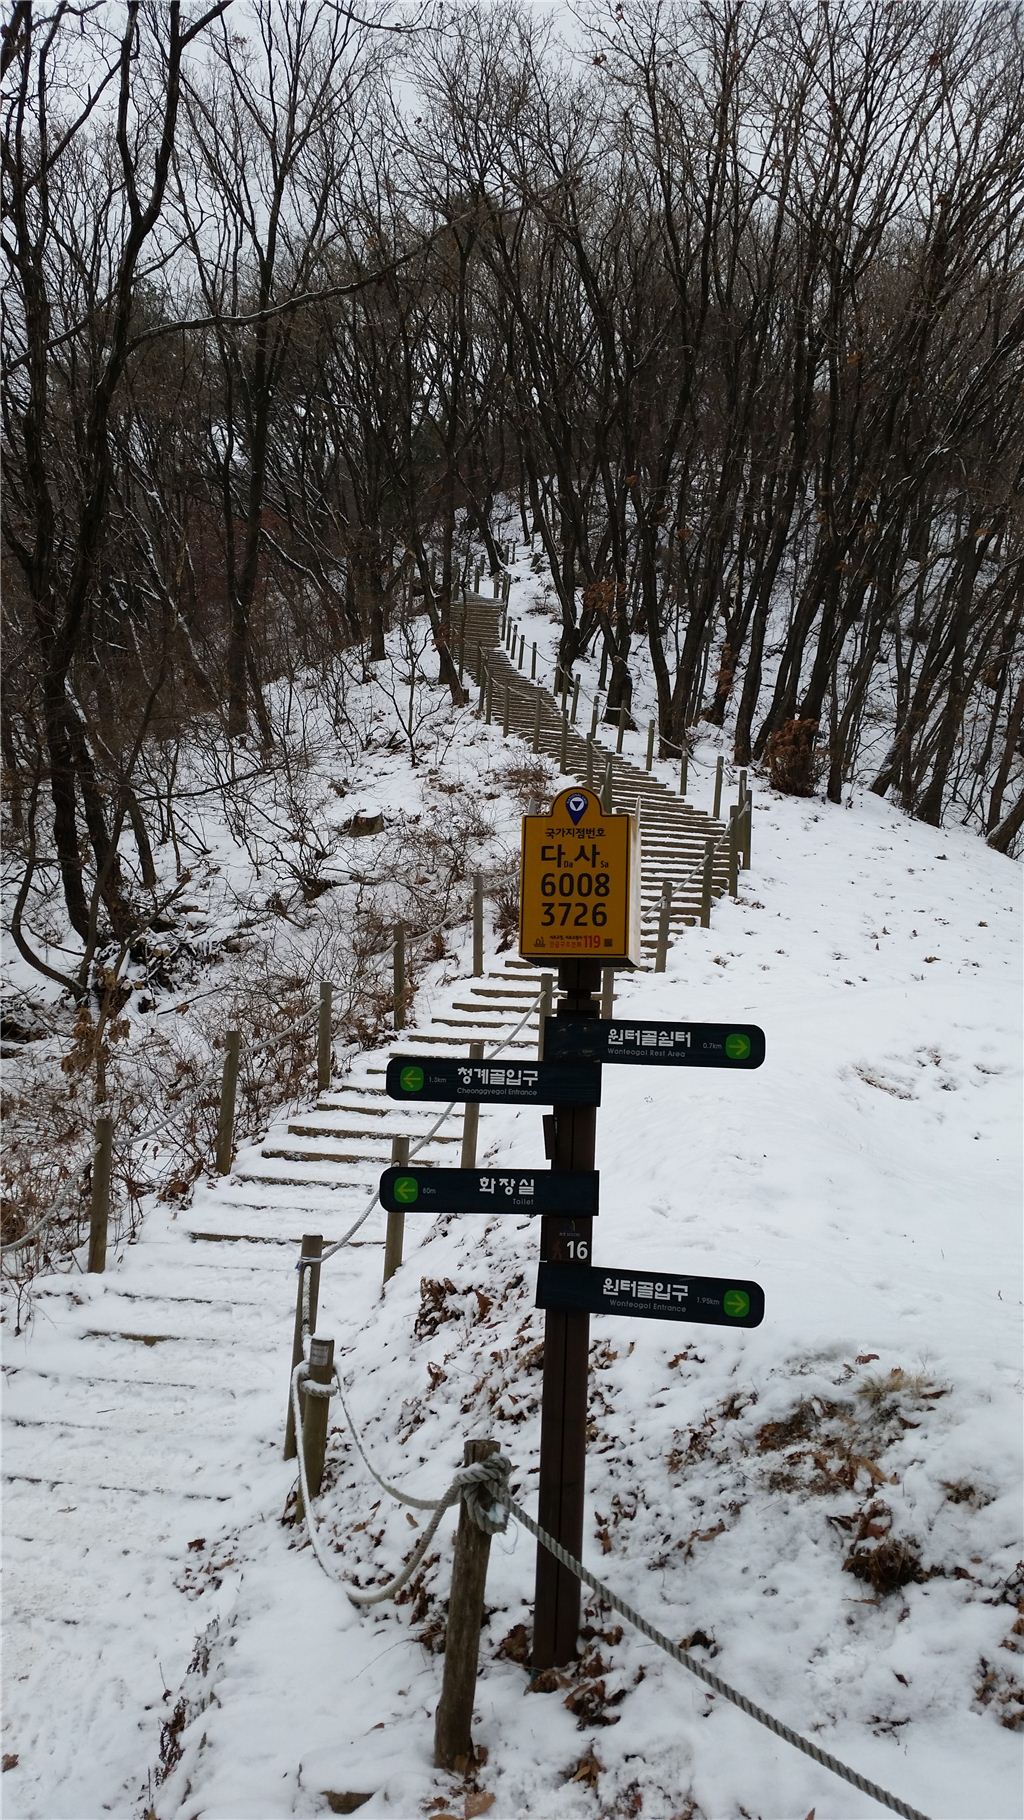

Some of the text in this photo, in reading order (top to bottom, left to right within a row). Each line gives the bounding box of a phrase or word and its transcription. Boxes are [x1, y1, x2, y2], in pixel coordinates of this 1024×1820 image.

[545, 828, 606, 839] 국가지점번호
[541, 844, 601, 868] 다 사
[541, 872, 610, 897] 6008
[541, 902, 607, 927] 3726
[584, 935, 601, 949] 119
[607, 1028, 691, 1048] 원터골쉼터
[457, 1067, 539, 1087] 청계골입구
[508, 1088, 538, 1096] Entrance
[479, 1177, 535, 1196] 화장실
[513, 1198, 534, 1206] Toilet
[566, 1240, 588, 1260] 16
[602, 1277, 689, 1302] 원터골입구
[653, 1303, 687, 1313] Entrance
